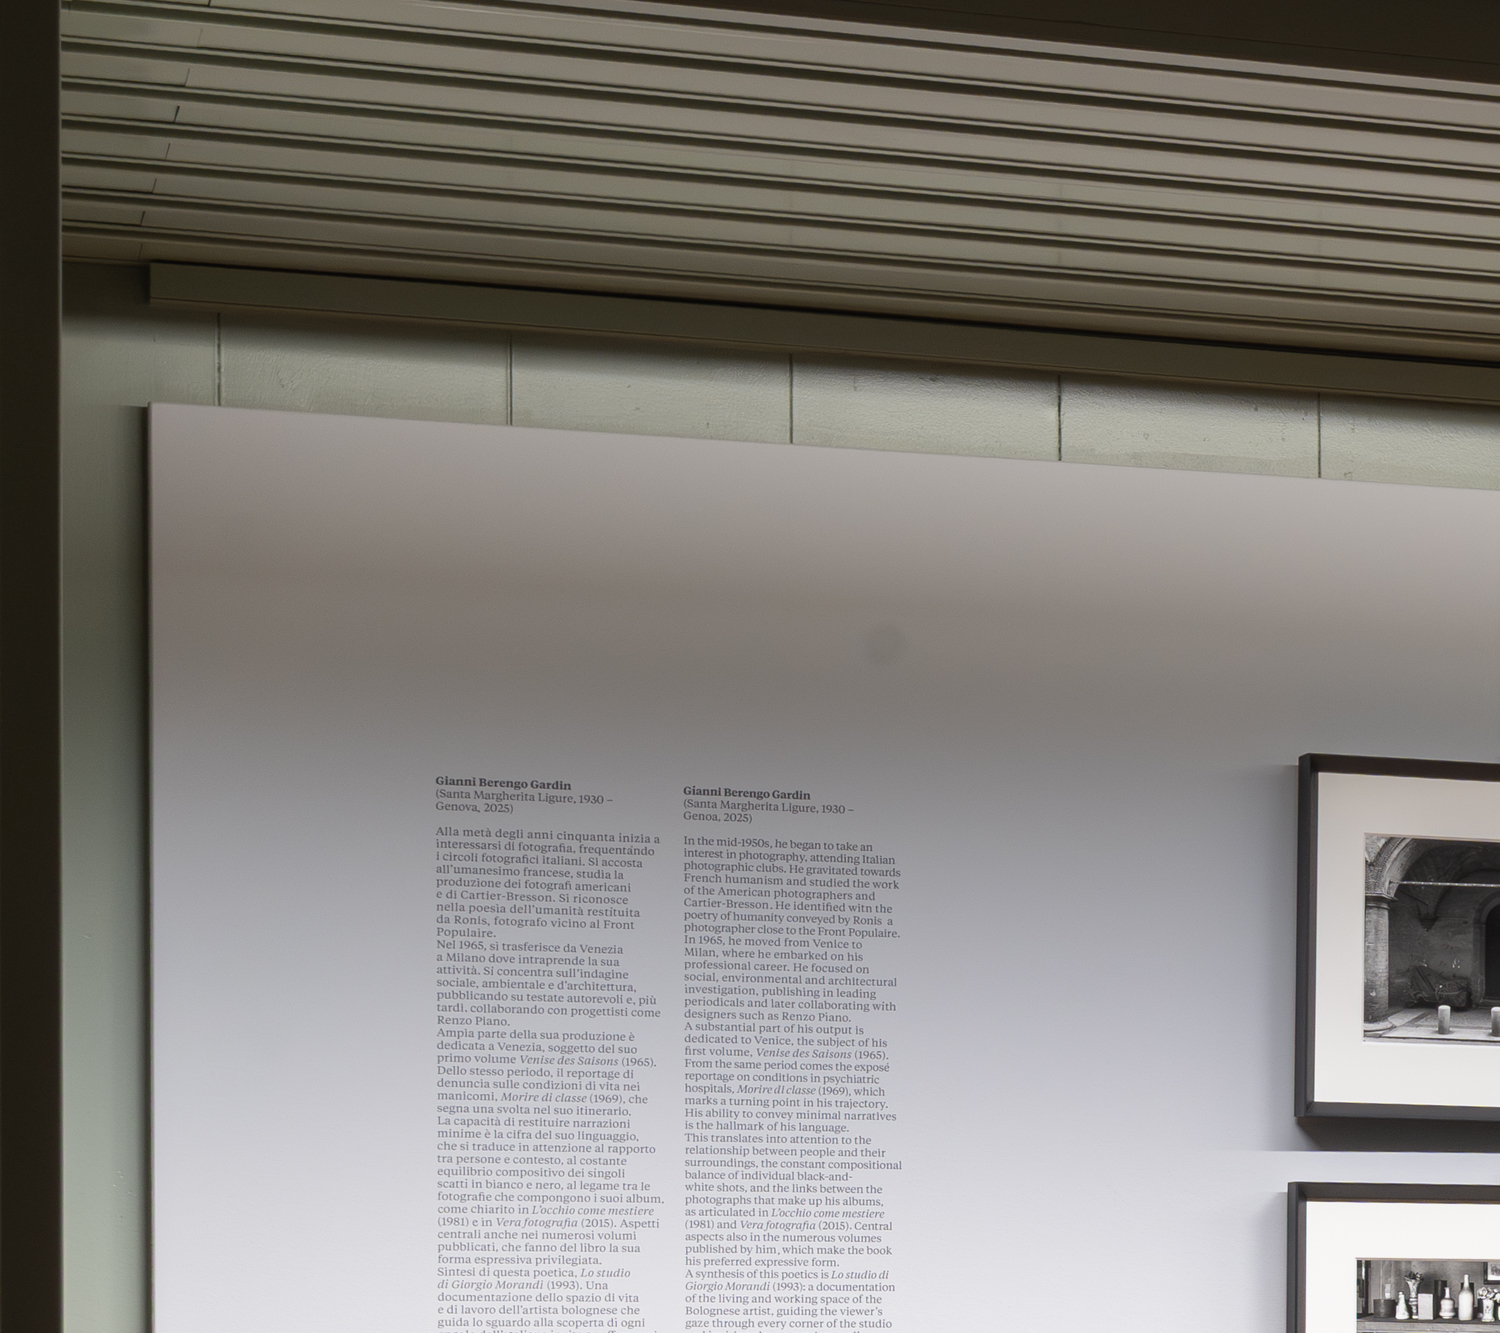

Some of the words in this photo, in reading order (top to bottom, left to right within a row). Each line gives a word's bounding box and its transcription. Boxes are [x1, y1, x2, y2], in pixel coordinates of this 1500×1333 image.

[435, 775, 477, 786] Gianni
[478, 777, 529, 790] Berengo
[530, 779, 572, 790] Gardin
[435, 788, 472, 800] (Santa
[473, 790, 536, 803] Margherita
[537, 792, 577, 805] Ligure,
[578, 794, 604, 804] 1930
[683, 786, 722, 796] Gianni
[723, 787, 771, 800] Berengo
[772, 789, 811, 800] Gardin
[435, 801, 481, 813] Genova,
[483, 803, 514, 815] 2025)
[683, 798, 718, 810] (Santa
[720, 800, 780, 813] Margherita
[781, 802, 820, 814] Ligure,
[822, 804, 846, 814] 1930
[683, 811, 722, 823] Genoa,
[723, 812, 753, 824] 2025)
[435, 826, 460, 836] Alla
[462, 827, 492, 837] metà
[494, 828, 524, 840] degli
[526, 829, 554, 840] anni
[556, 830, 616, 844] cinquanta
[618, 833, 651, 843] inizia
[684, 835, 695, 845] In
[697, 836, 715, 846] the
[716, 837, 773, 849] mid-1950s,
[774, 839, 788, 848] he
[790, 839, 822, 851] began
[823, 841, 835, 850] to
[836, 841, 859, 851] take
[436, 876, 502, 890] produzione
[503, 879, 522, 889] dei
[524, 879, 573, 892] fotografi
[574, 881, 632, 892] americani
[436, 927, 497, 939] Populaire.
[436, 939, 456, 949] Nel
[459, 940, 487, 951] 1965,
[489, 941, 499, 950] si
[502, 941, 561, 952] trasferisce
[563, 943, 577, 953] da
[579, 944, 624, 954] Venezia
[684, 947, 719, 958] Milan,
[721, 948, 756, 958] where
[757, 949, 772, 959] he
[773, 950, 828, 960] embarked
[847, 952, 864, 961] his
[437, 1015, 473, 1025] Renzo
[474, 1016, 511, 1026] Piano.
[684, 1009, 737, 1021] designers
[738, 1010, 765, 1020] such
[781, 1011, 816, 1021] Renzo
[818, 1012, 852, 1022] Piano.
[437, 1053, 472, 1064] primo
[474, 1053, 517, 1064] volume
[520, 1054, 556, 1064] Venise
[556, 1055, 576, 1065] des
[577, 1056, 619, 1066] Saisons
[621, 1057, 657, 1068] (1965).
[684, 1046, 707, 1055] first
[708, 1046, 753, 1058] volume,
[756, 1047, 791, 1057] Venise
[792, 1048, 810, 1058] des
[811, 1049, 853, 1059] Saisons
[854, 1050, 889, 1061] (1965).
[438, 1254, 472, 1264] forma
[474, 1254, 533, 1266] espressiva
[534, 1255, 602, 1266] privilegiata.
